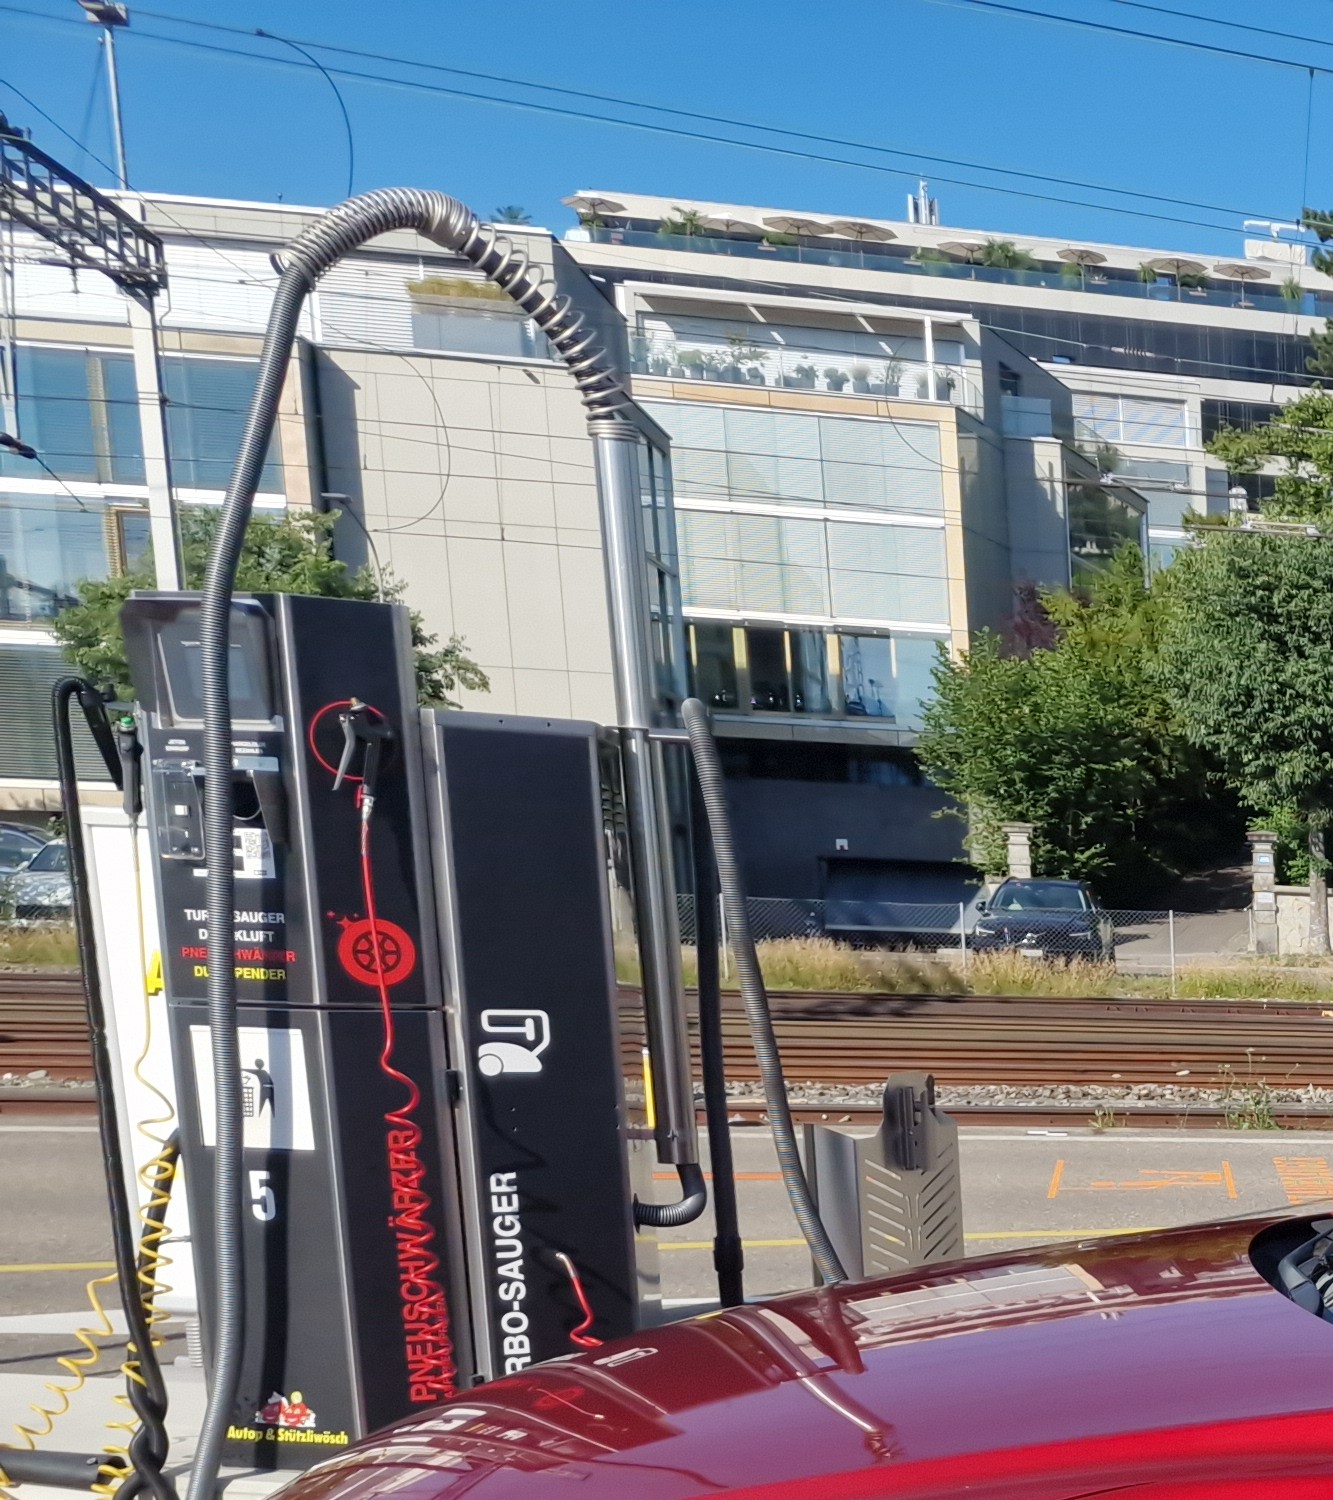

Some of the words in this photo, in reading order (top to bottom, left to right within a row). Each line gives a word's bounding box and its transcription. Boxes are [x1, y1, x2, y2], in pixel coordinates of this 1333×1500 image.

[184, 909, 285, 924] TURSAUGER
[198, 929, 275, 943] DKLUFT
[249, 1170, 276, 1221] 5
[227, 1425, 263, 1442] Autop
[265, 1428, 276, 1441] &
[277, 1428, 349, 1445] Stützliwösch
